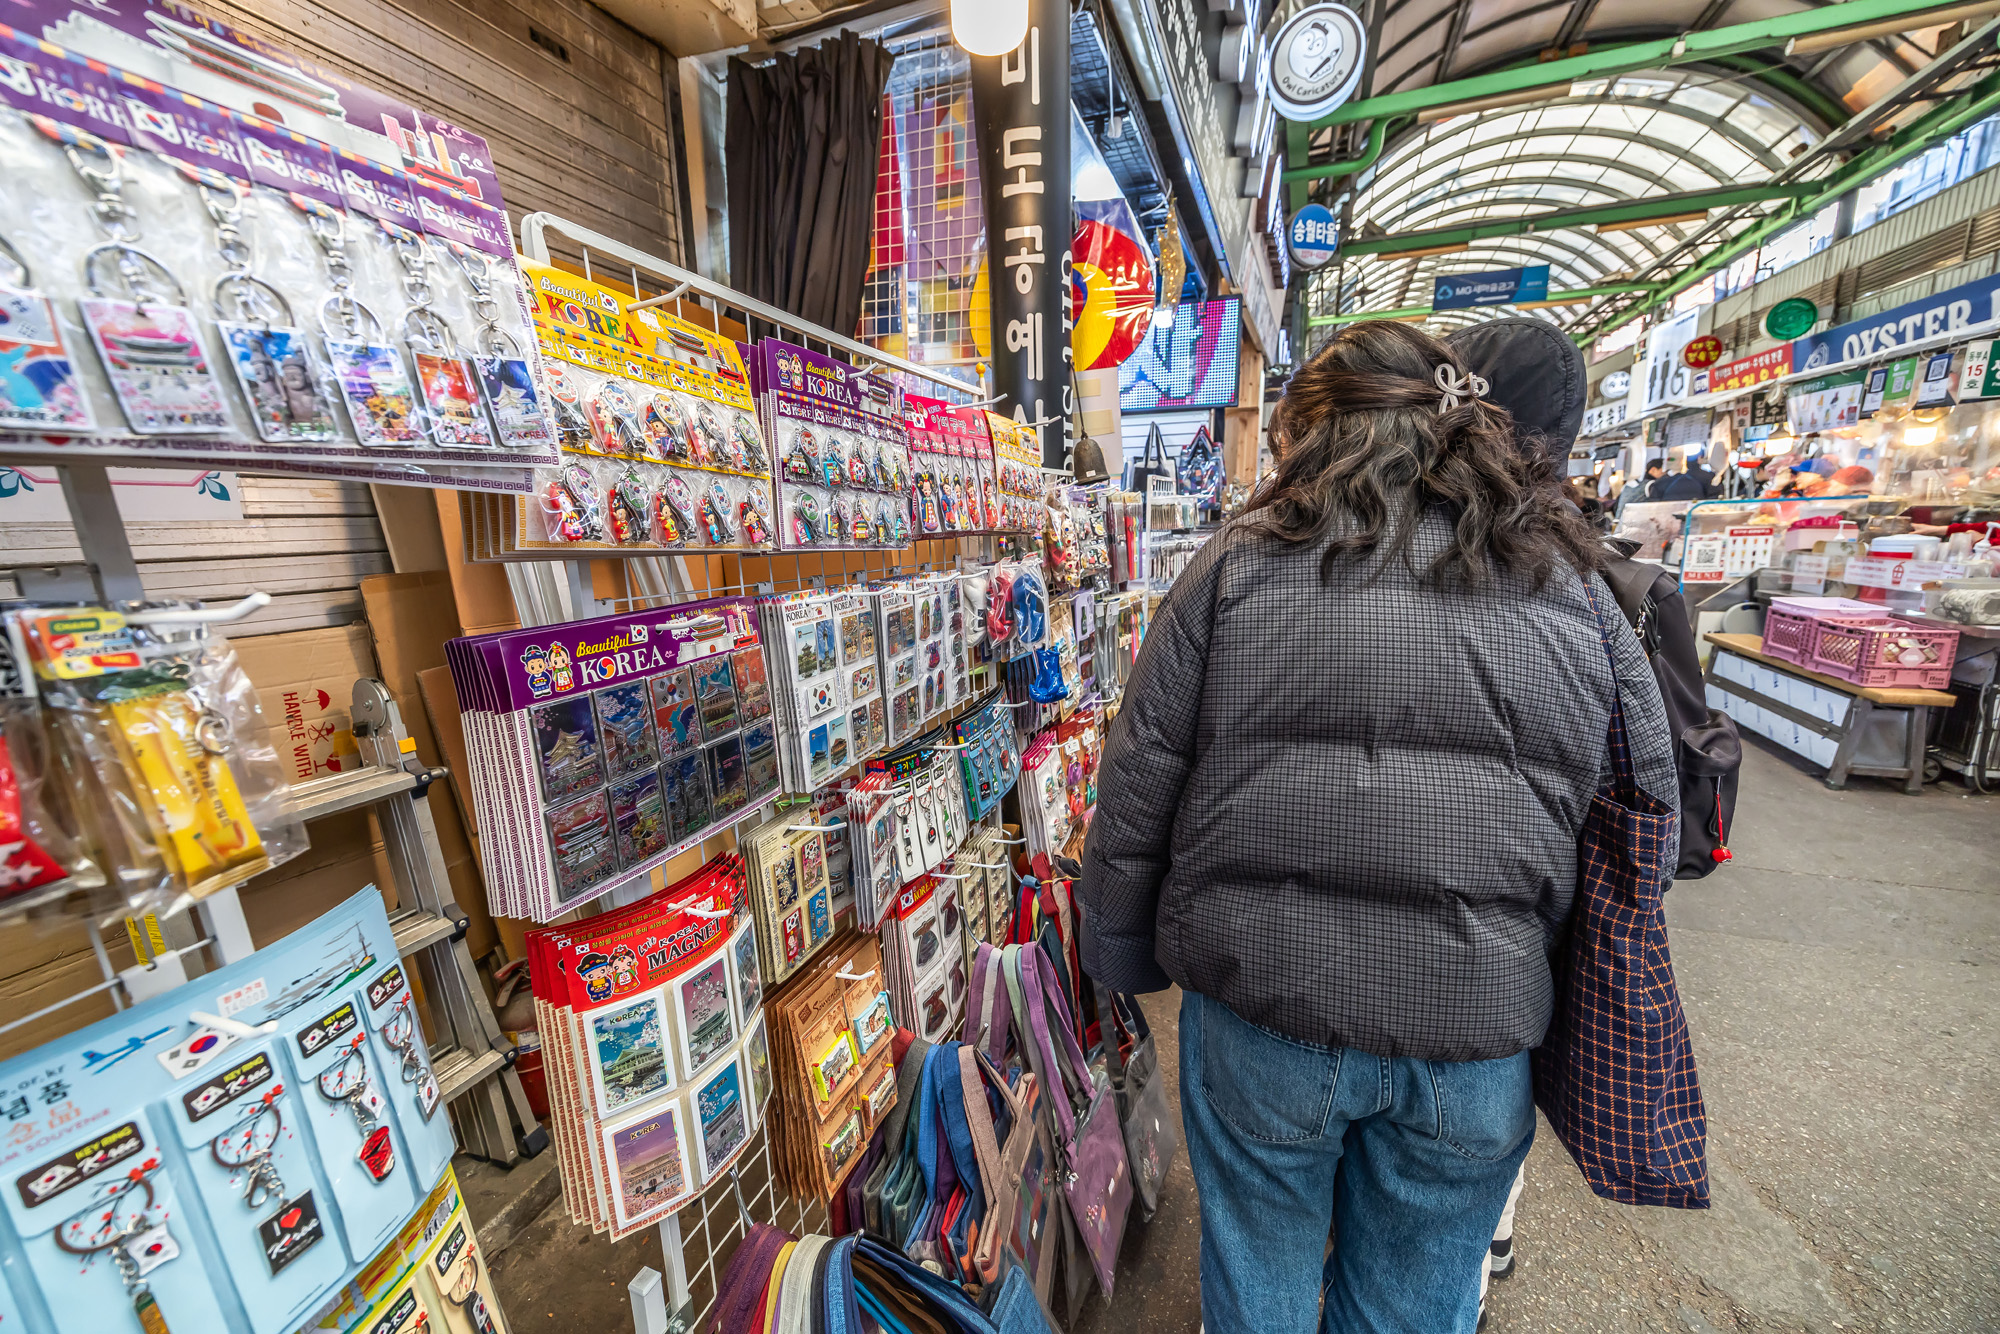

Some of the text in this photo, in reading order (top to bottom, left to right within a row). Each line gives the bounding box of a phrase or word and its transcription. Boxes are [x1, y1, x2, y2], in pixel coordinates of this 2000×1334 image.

[1282, 69, 1344, 96] Owl Caricature
[448, 213, 506, 247] KOREA
[1294, 219, 1337, 246] 송월타올
[540, 276, 601, 308] Beautiful
[542, 293, 643, 348] KOREA
[1842, 299, 1972, 362] OYSTER
[806, 361, 837, 381] Beautiful
[1968, 364, 1984, 377] 15
[807, 374, 854, 405] KOREA
[1736, 407, 1749, 417] 16
[517, 430, 549, 441] KOREA
[1688, 571, 1718, 580] MENU
[784, 603, 798, 612] MADE
[785, 608, 809, 622] KOREA
[834, 601, 853, 612] KOREA
[576, 633, 632, 658] Beautiful
[577, 645, 667, 686] KOREA
[283, 692, 313, 778] HANDLE WITH
[716, 719, 737, 733] KOREA
[625, 753, 653, 771] KOREA
[566, 773, 600, 794] KOREA
[581, 863, 614, 887] KOREA
[592, 914, 678, 949] 정성을 다하여 준비 하였습니다
[659, 922, 699, 948] KOREA
[646, 917, 722, 971] MAGNET
[649, 967, 675, 981] Korean
[676, 946, 707, 969] traditional
[693, 970, 713, 988] KOREA
[609, 1009, 642, 1025] KOREA
[223, 1055, 265, 1083] KEY RING
[709, 1076, 728, 1097] KOREA
[75, 1126, 133, 1160] KEY RING
[630, 1122, 661, 1141] KOREA
[272, 1220, 281, 1237] I
